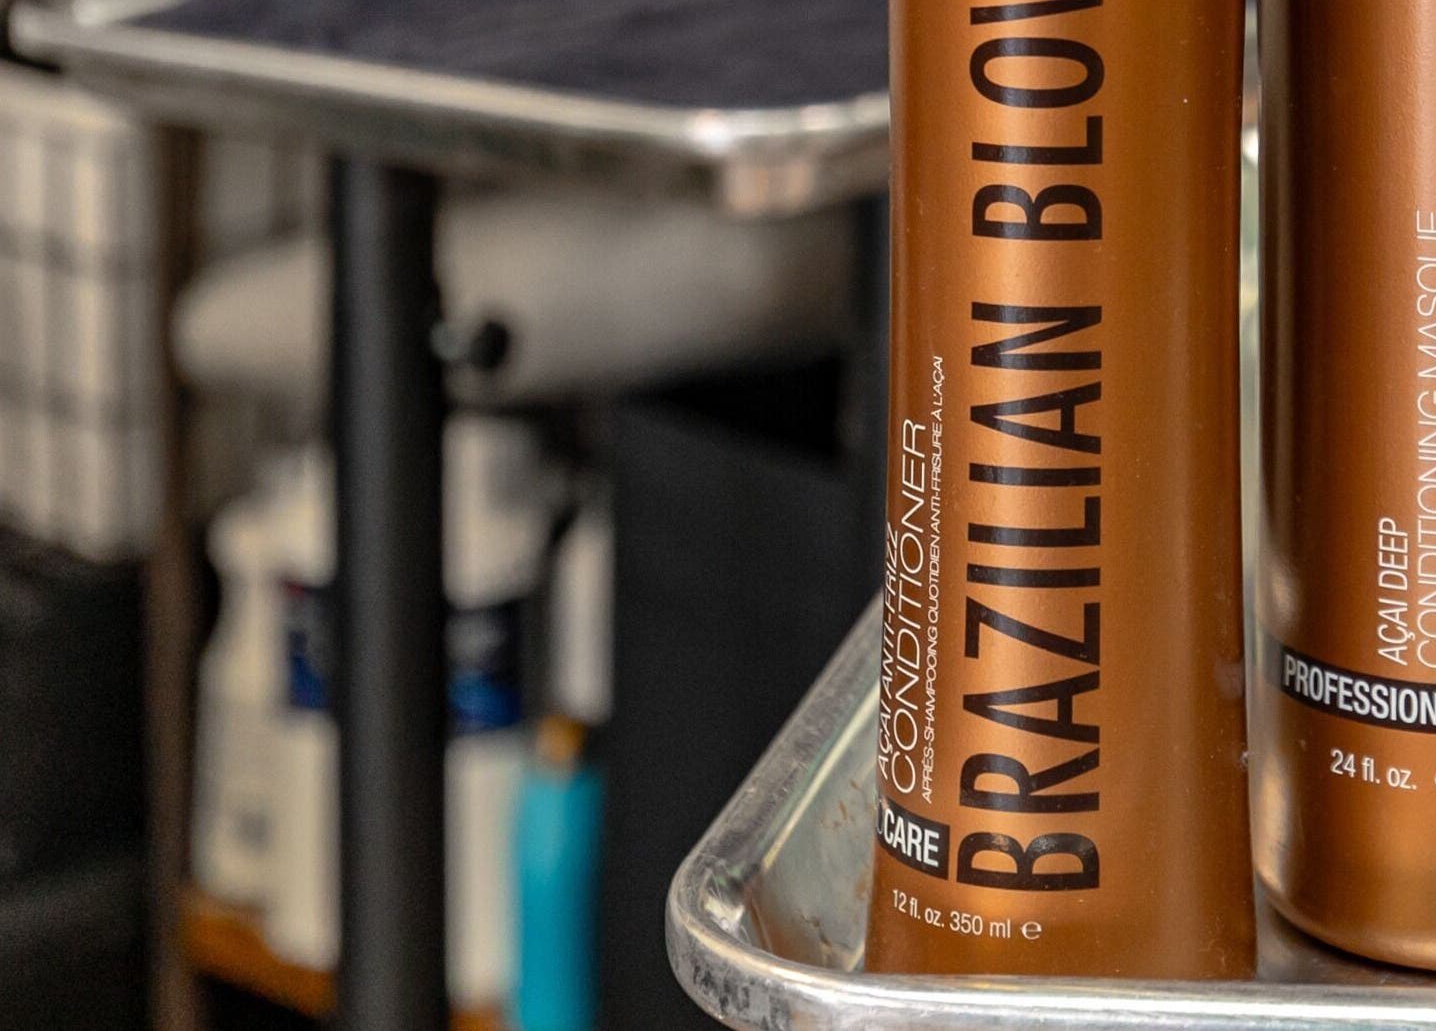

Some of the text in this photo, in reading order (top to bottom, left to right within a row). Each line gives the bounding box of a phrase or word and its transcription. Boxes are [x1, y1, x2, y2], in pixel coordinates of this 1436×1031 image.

[930, 422, 943, 534] ANTI-FRISURE
[891, 419, 926, 794] CONDITIONER
[927, 534, 941, 624] QUOTIDIEN
[956, 301, 1100, 891] BRAZILIAN
[1378, 517, 1418, 665] AÇAI DEEP
[1330, 749, 1356, 778] 24
[1362, 758, 1381, 785] fl.
[1386, 768, 1417, 790] oz.
[892, 889, 907, 914] 12
[909, 896, 921, 920] fl.
[925, 907, 945, 928] oz.
[949, 910, 983, 936] 350
[989, 919, 1011, 939] ml
